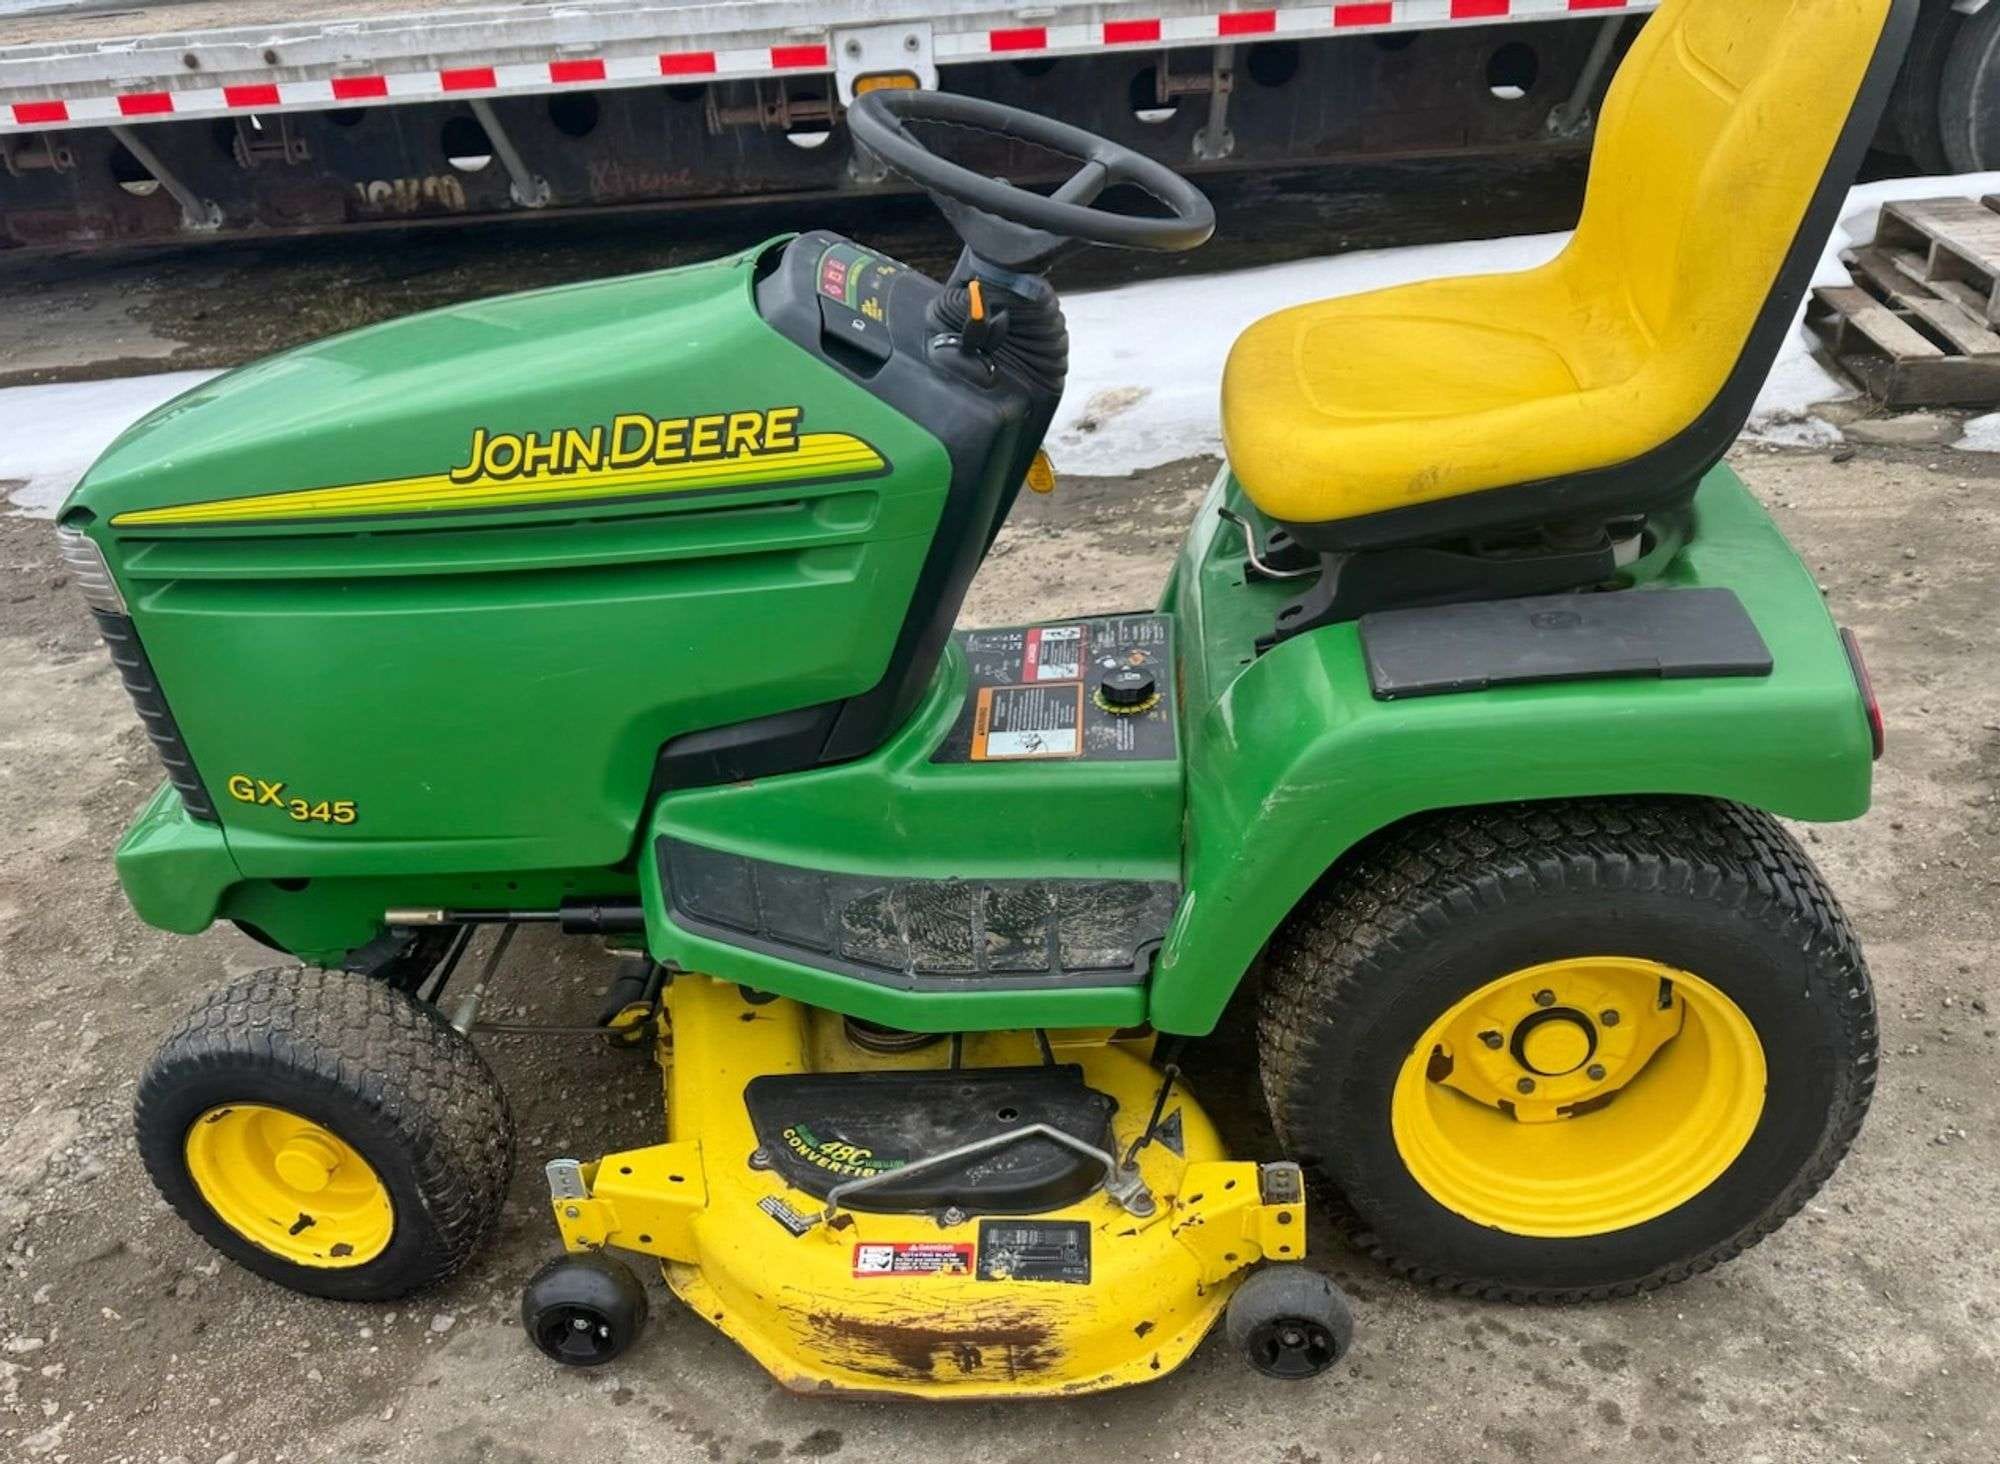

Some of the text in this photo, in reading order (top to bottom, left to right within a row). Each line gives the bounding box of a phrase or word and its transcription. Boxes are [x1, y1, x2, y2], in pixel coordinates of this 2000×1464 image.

[450, 405, 803, 484] JOHN DEERE
[228, 773, 358, 825] GX 345
[783, 1128, 886, 1178] CONVERTIB
[819, 1140, 873, 1166] 48C
